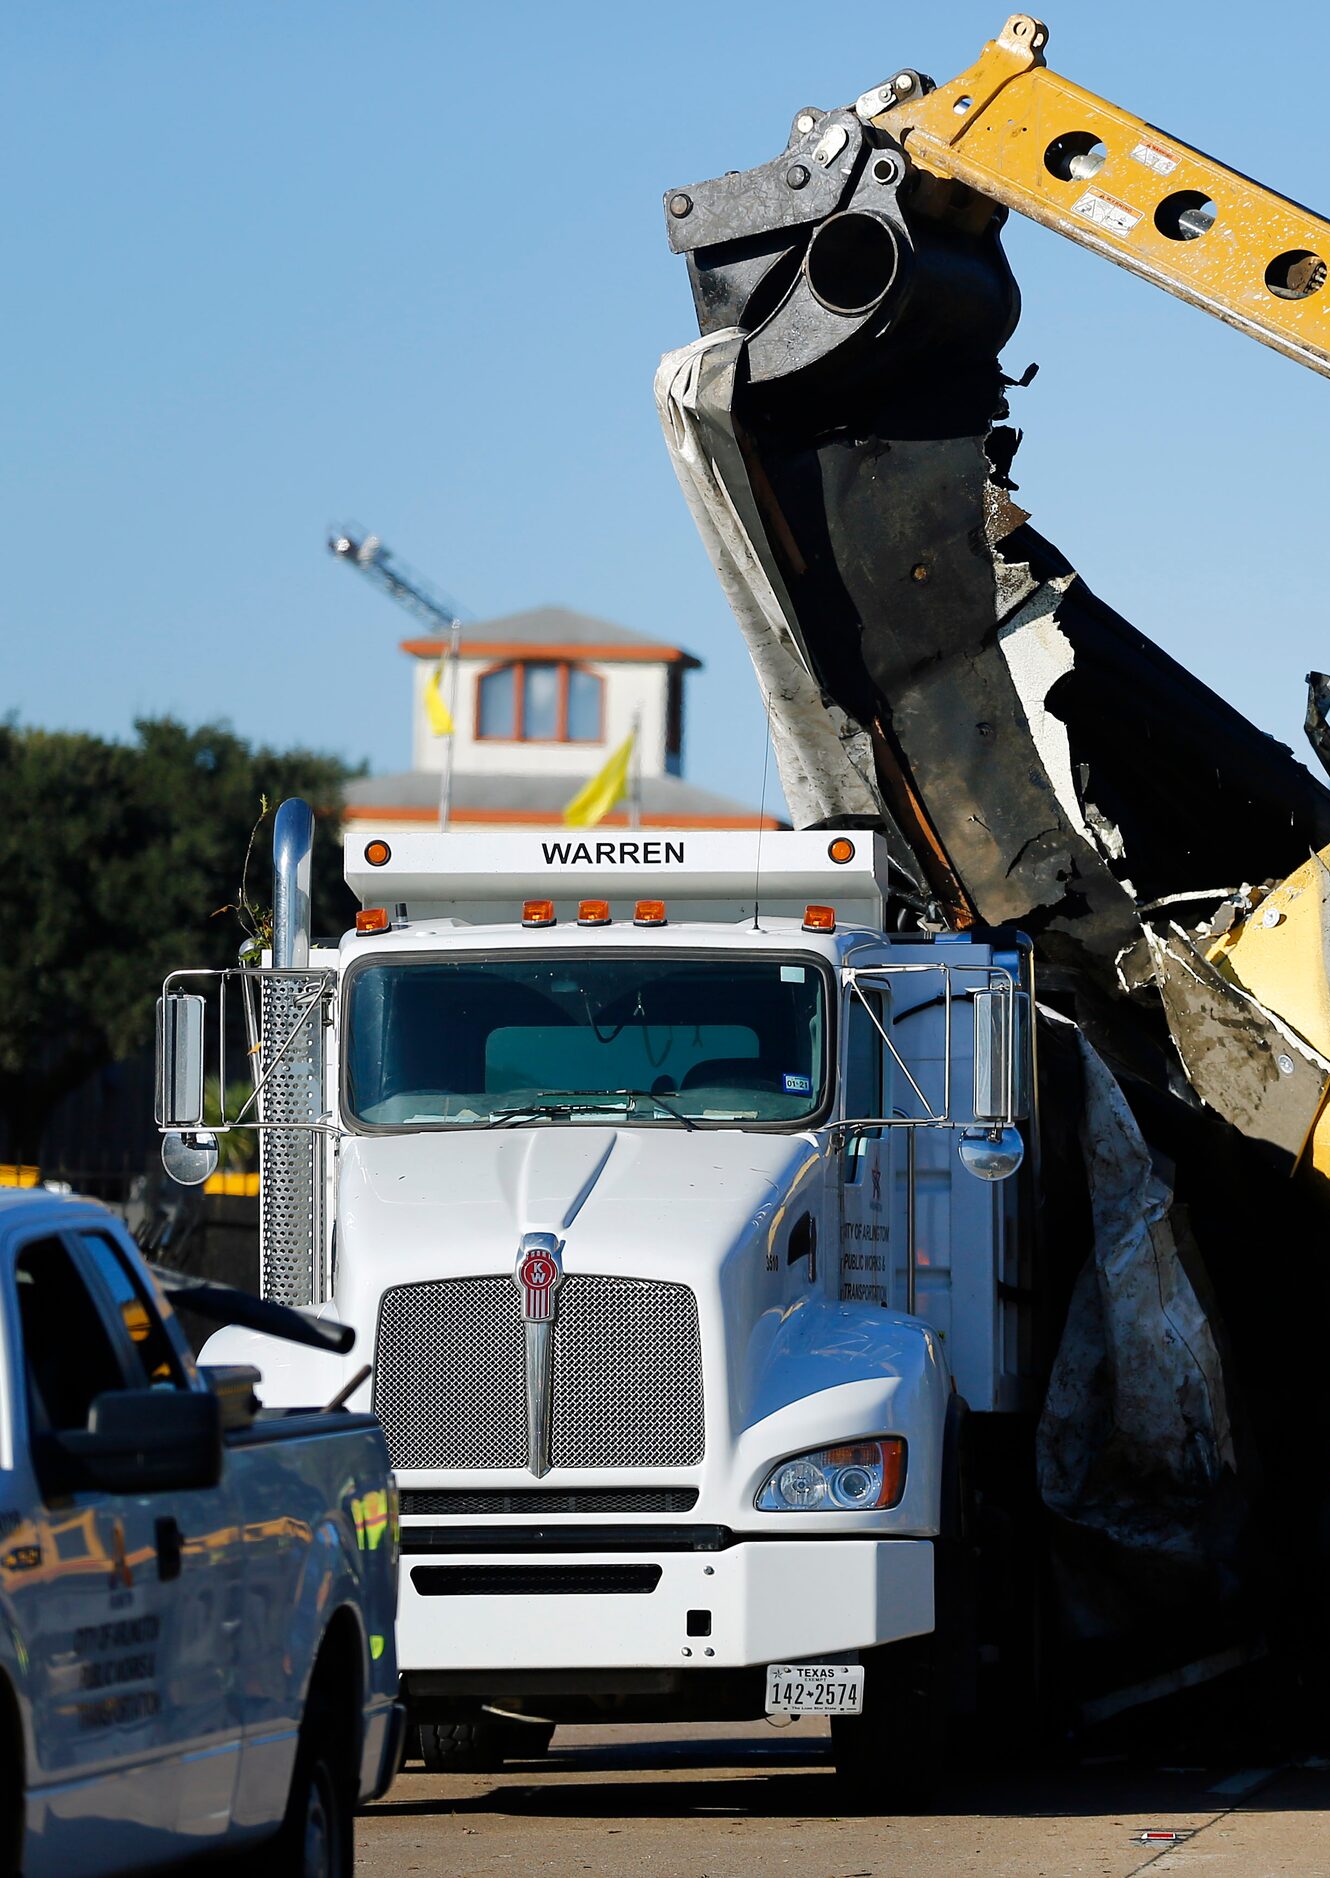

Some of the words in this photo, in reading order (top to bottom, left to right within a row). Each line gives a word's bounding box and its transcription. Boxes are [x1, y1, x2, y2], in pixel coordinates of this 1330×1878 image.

[541, 842, 684, 864] WARREN
[843, 1253, 864, 1270] PUBLIC
[796, 1668, 835, 1678] TEXAS
